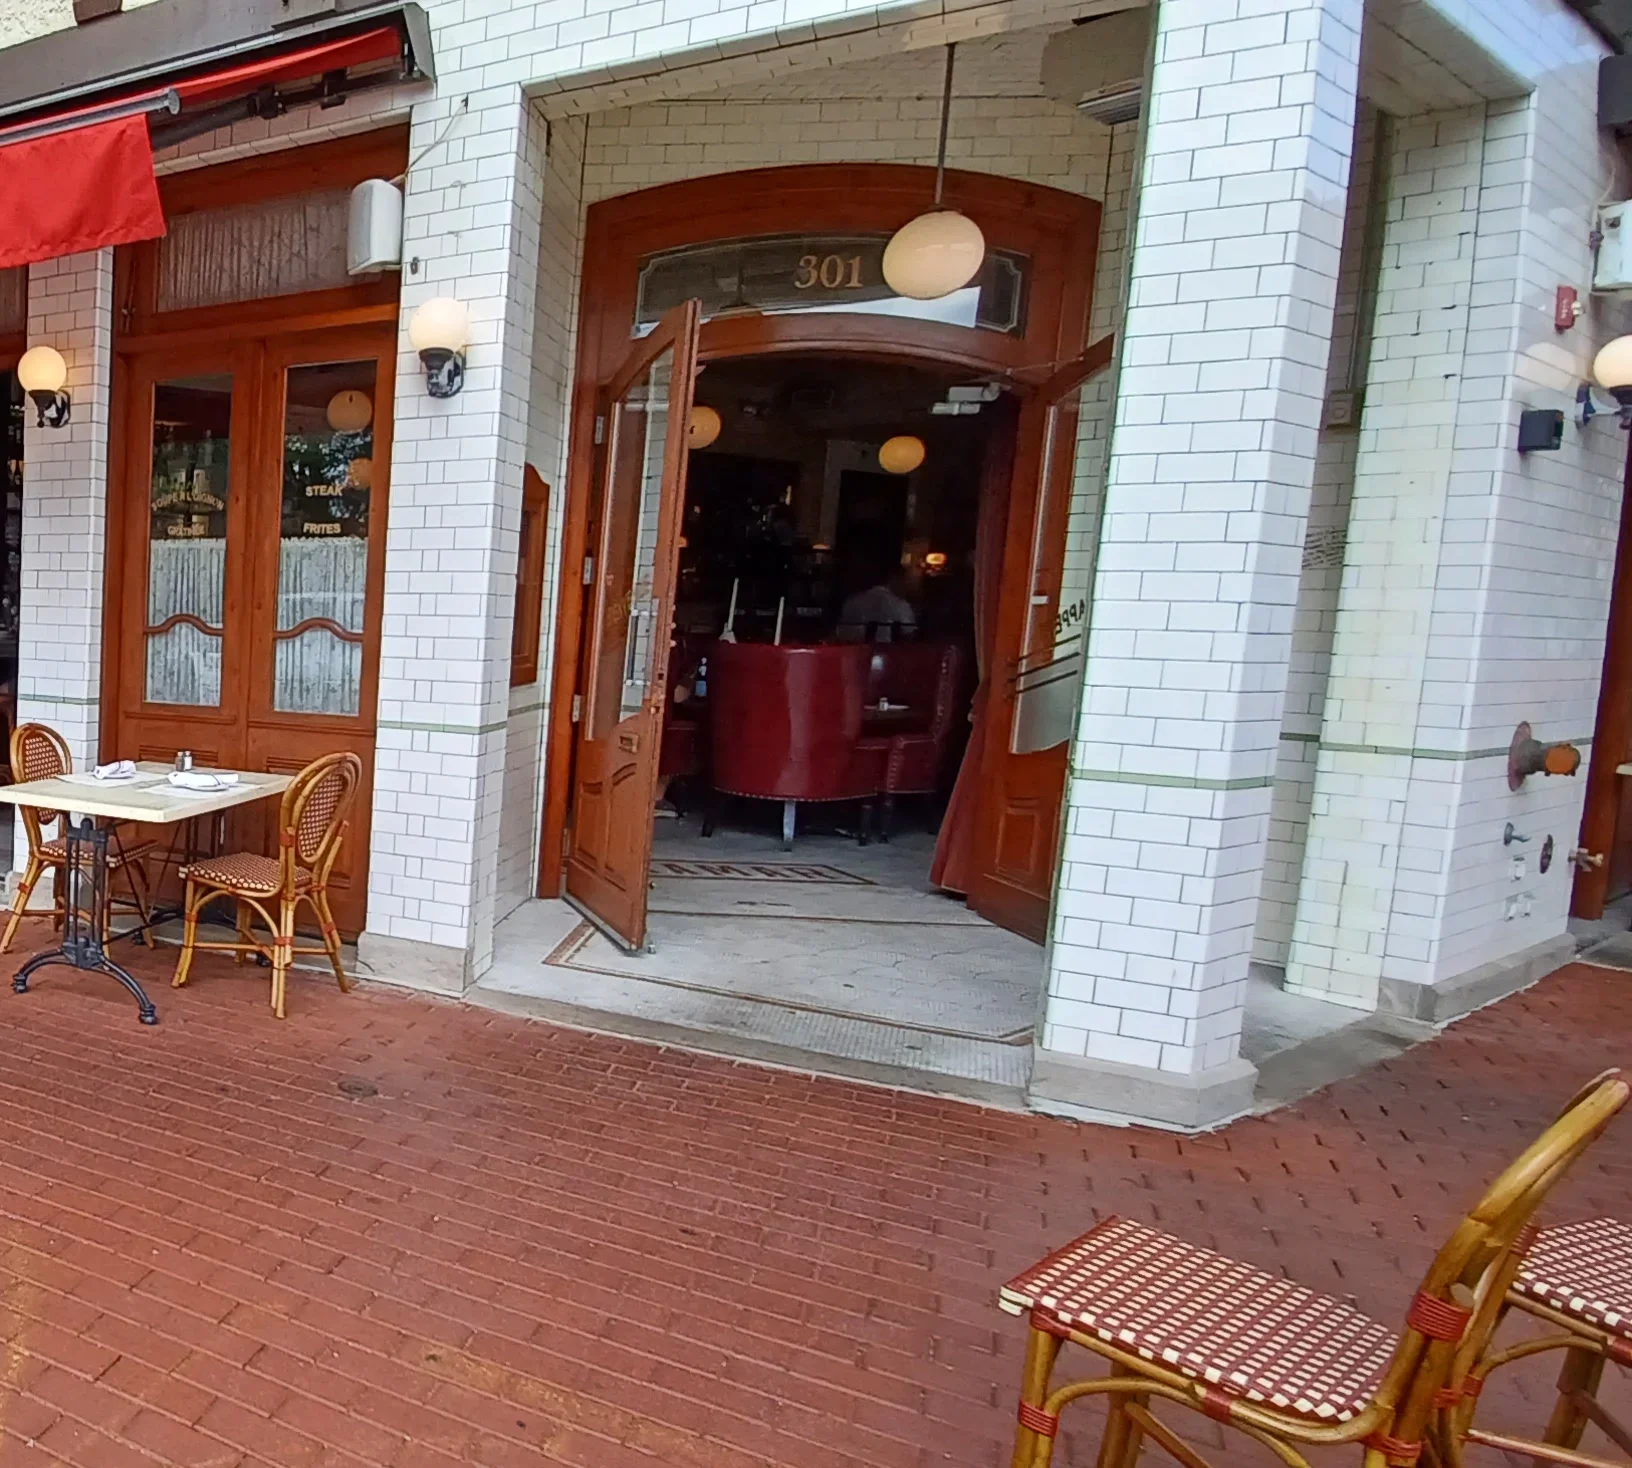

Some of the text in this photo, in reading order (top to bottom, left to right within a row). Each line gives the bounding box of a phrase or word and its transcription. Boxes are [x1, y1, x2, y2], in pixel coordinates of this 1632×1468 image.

[794, 254, 864, 289] 301
[305, 484, 344, 497] STEAK
[303, 522, 342, 534] FRITES
[650, 862, 838, 880] AMAR
